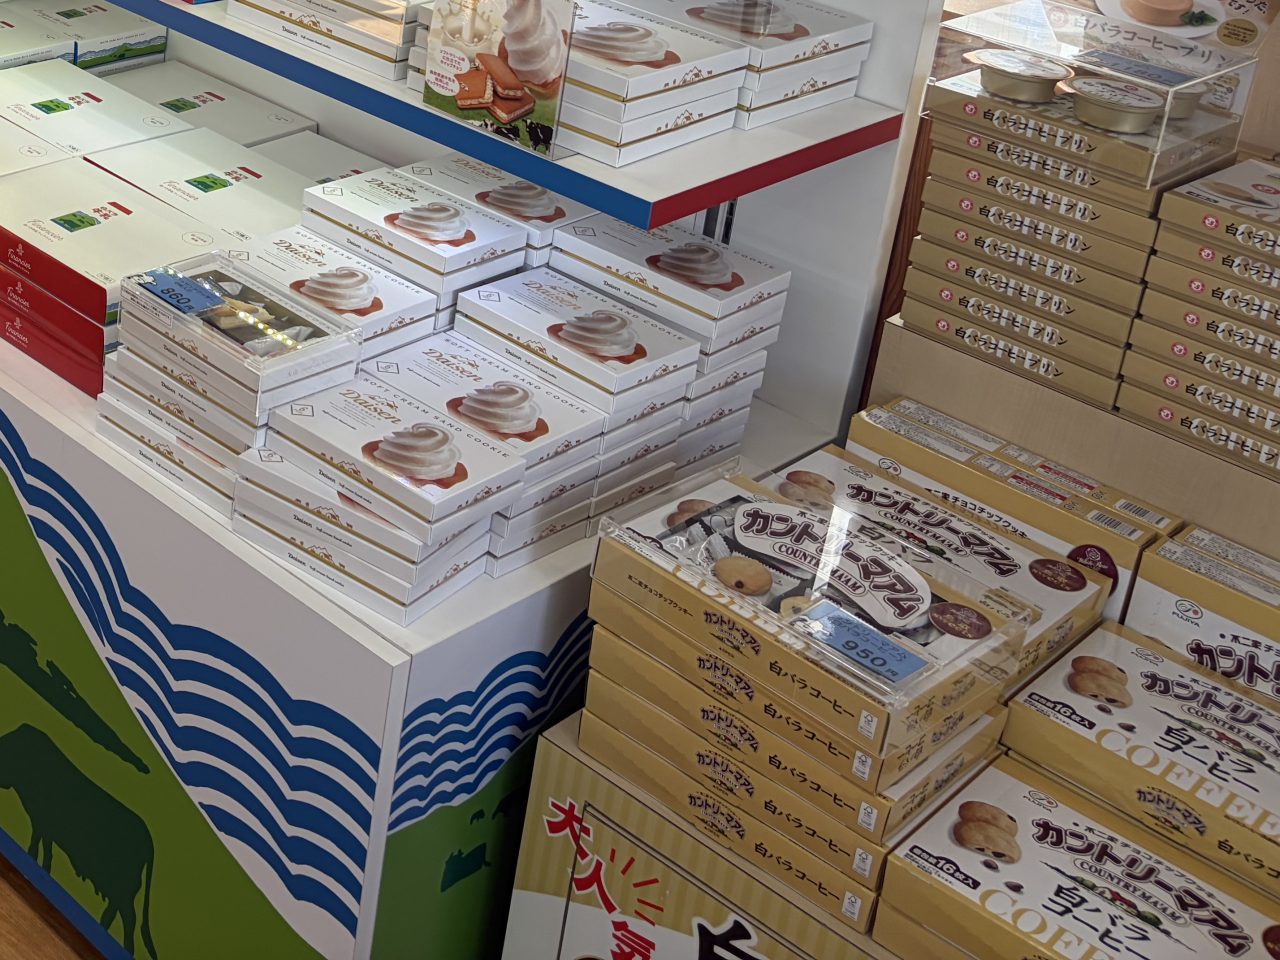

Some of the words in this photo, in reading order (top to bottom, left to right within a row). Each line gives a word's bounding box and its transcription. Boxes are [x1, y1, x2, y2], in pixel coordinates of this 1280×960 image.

[983, 109, 1097, 154] 白バラコーヒープリン
[987, 142, 1101, 187] 白バラコーヒープリン
[987, 175, 1101, 222] 白バラコーヒープリン
[978, 205, 1092, 253] 白バラコーヒープリン
[272, 239, 327, 268] Daisen
[974, 236, 1087, 283] 白バラコーヒープリン
[523, 279, 583, 311] Daisen
[965, 266, 1076, 316] 白バラコーヒープリン
[958, 296, 1068, 346] 白バラコーヒープリン
[421, 347, 483, 383] Daisen
[955, 327, 1064, 378] 白バラコーヒープリン
[338, 388, 402, 426] Daisen
[363, 377, 389, 393] SOFT
[393, 393, 429, 416] CREAM
[432, 415, 463, 433] SAND
[467, 433, 510, 459] COOKIE
[848, 483, 1022, 578] カントリーマアム
[704, 610, 762, 656] カントリーマアム
[1172, 612, 1201, 628] FUJIYA
[697, 656, 755, 701] カントリーマアム
[841, 639, 899, 678] 950円
[769, 660, 855, 719] 白バラコーヒー
[700, 707, 760, 753] カントリーマアム
[763, 703, 850, 760] 白バラコーヒー
[1164, 725, 1257, 774] 白バラ
[697, 751, 755, 798] カントリーマアム
[768, 754, 856, 812] 白バラコーヒー
[1154, 735, 1260, 793] コーヒー
[688, 792, 746, 840] カントリーマアム
[763, 799, 850, 857] 白バラコーヒー
[754, 842, 840, 901] 白バラコーヒー
[1031, 818, 1254, 957] カントリーマアム
[1079, 862, 1146, 903] COUNTRY
[1142, 891, 1181, 924] MA'AM
[1055, 884, 1151, 942] 白バラ
